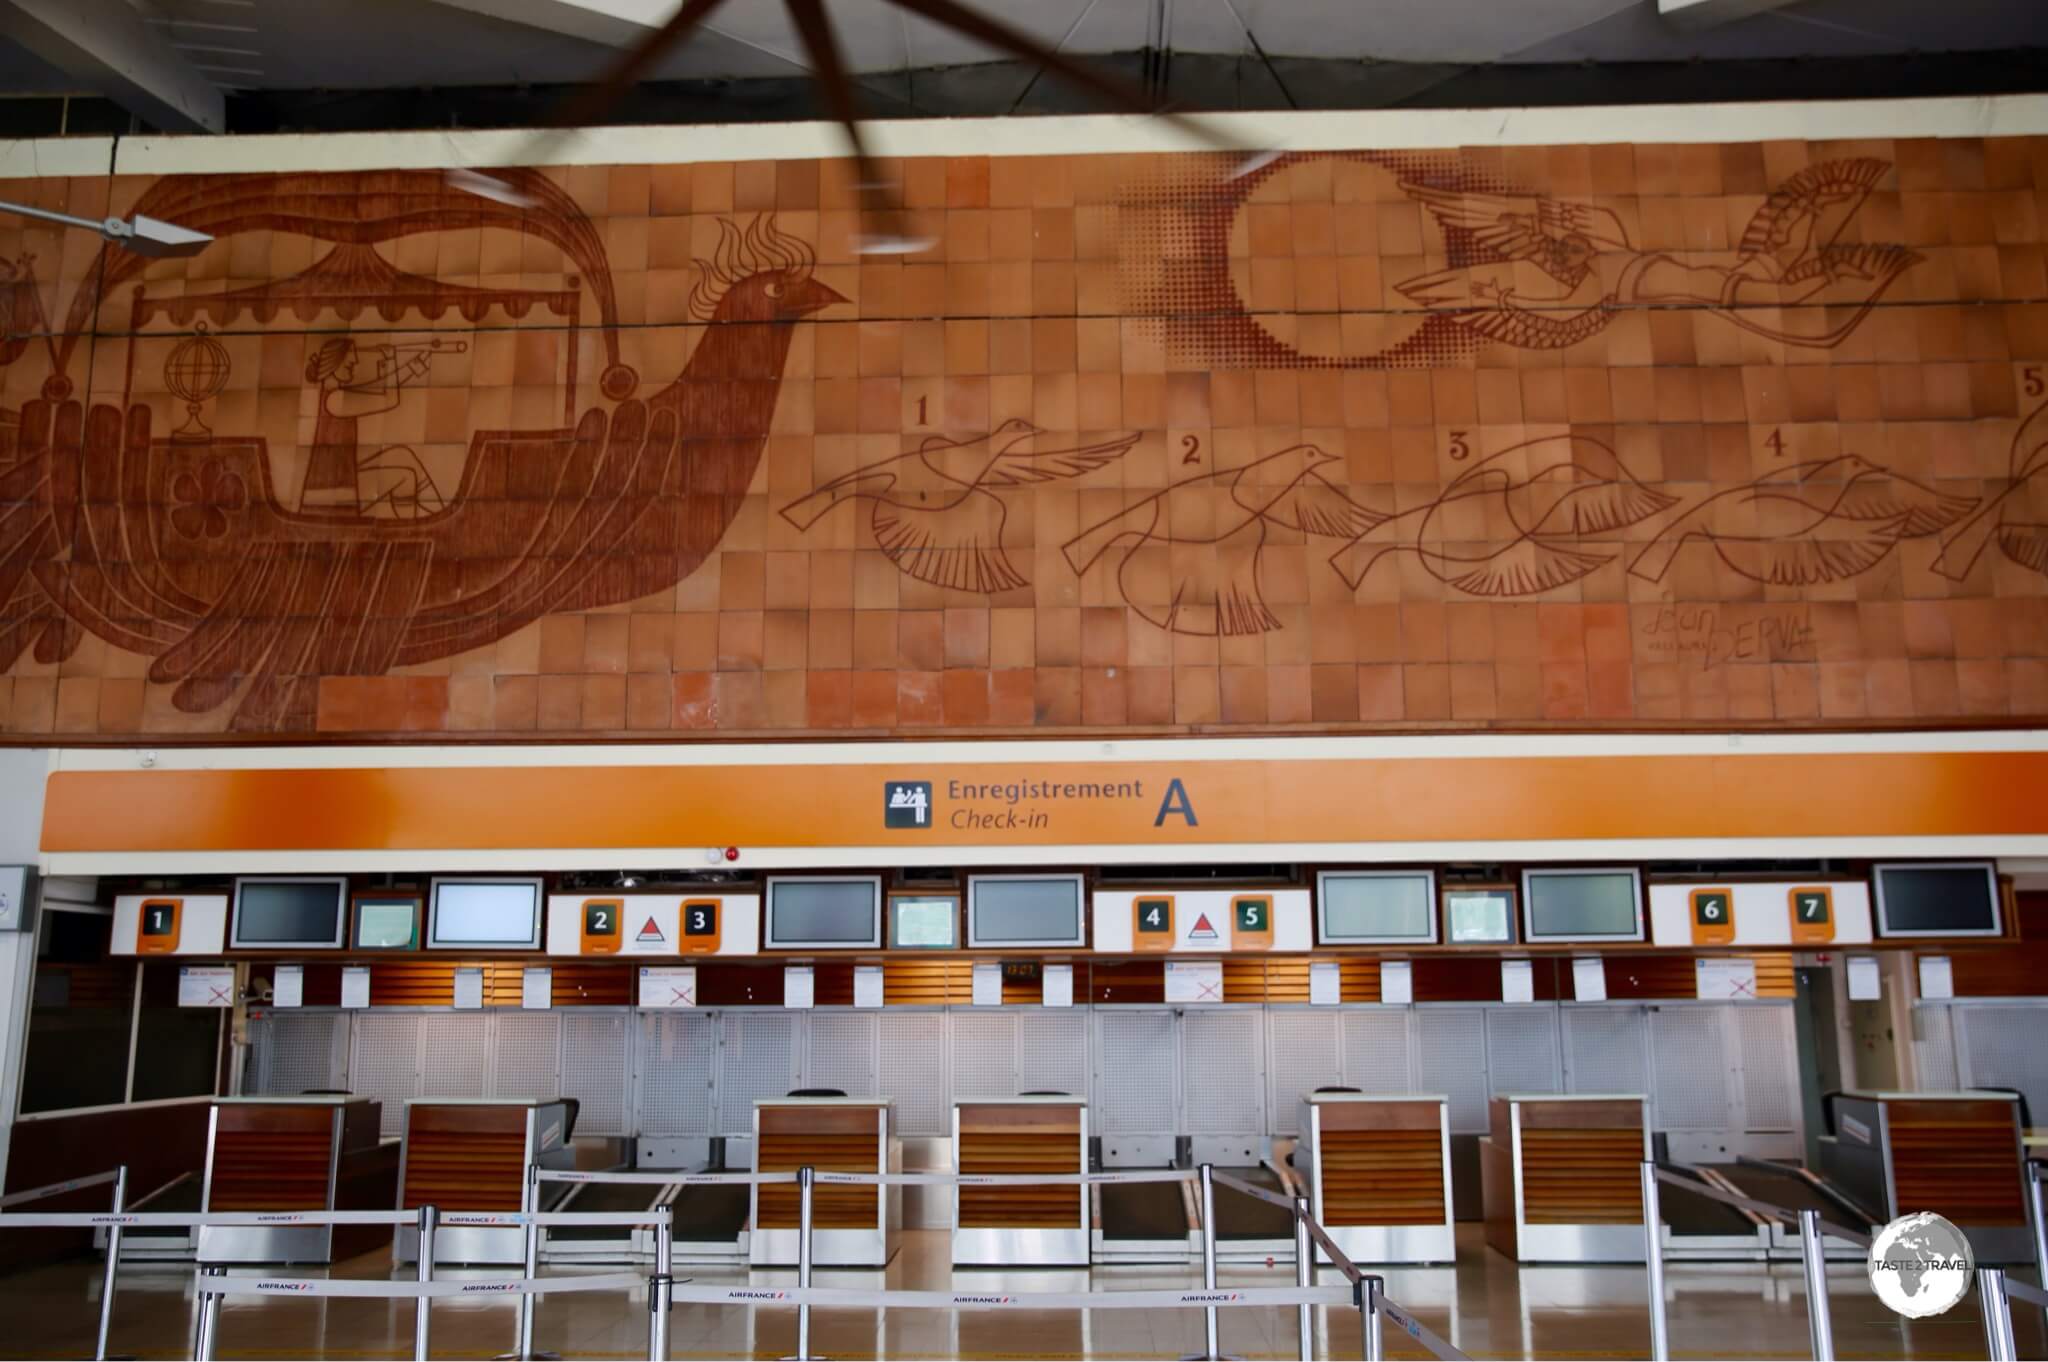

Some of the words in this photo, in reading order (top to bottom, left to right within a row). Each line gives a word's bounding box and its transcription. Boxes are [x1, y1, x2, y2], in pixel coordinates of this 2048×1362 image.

[2023, 367, 2045, 397] 5
[914, 395, 928, 426] 1
[1182, 434, 1200, 464] 2
[1449, 431, 1469, 461] 3
[1763, 426, 1788, 457] 4
[948, 778, 1143, 804] Enregistrement
[1153, 778, 1199, 827] A
[950, 808, 1049, 829] Check-in
[1146, 908, 1160, 926] 4
[1245, 907, 1258, 926] 5
[1704, 900, 1719, 919] 6
[1804, 899, 1818, 917] 7
[153, 911, 162, 929] 1
[594, 911, 607, 929] 2
[693, 911, 705, 929] 3
[728, 1291, 776, 1299] AIRFRANCE
